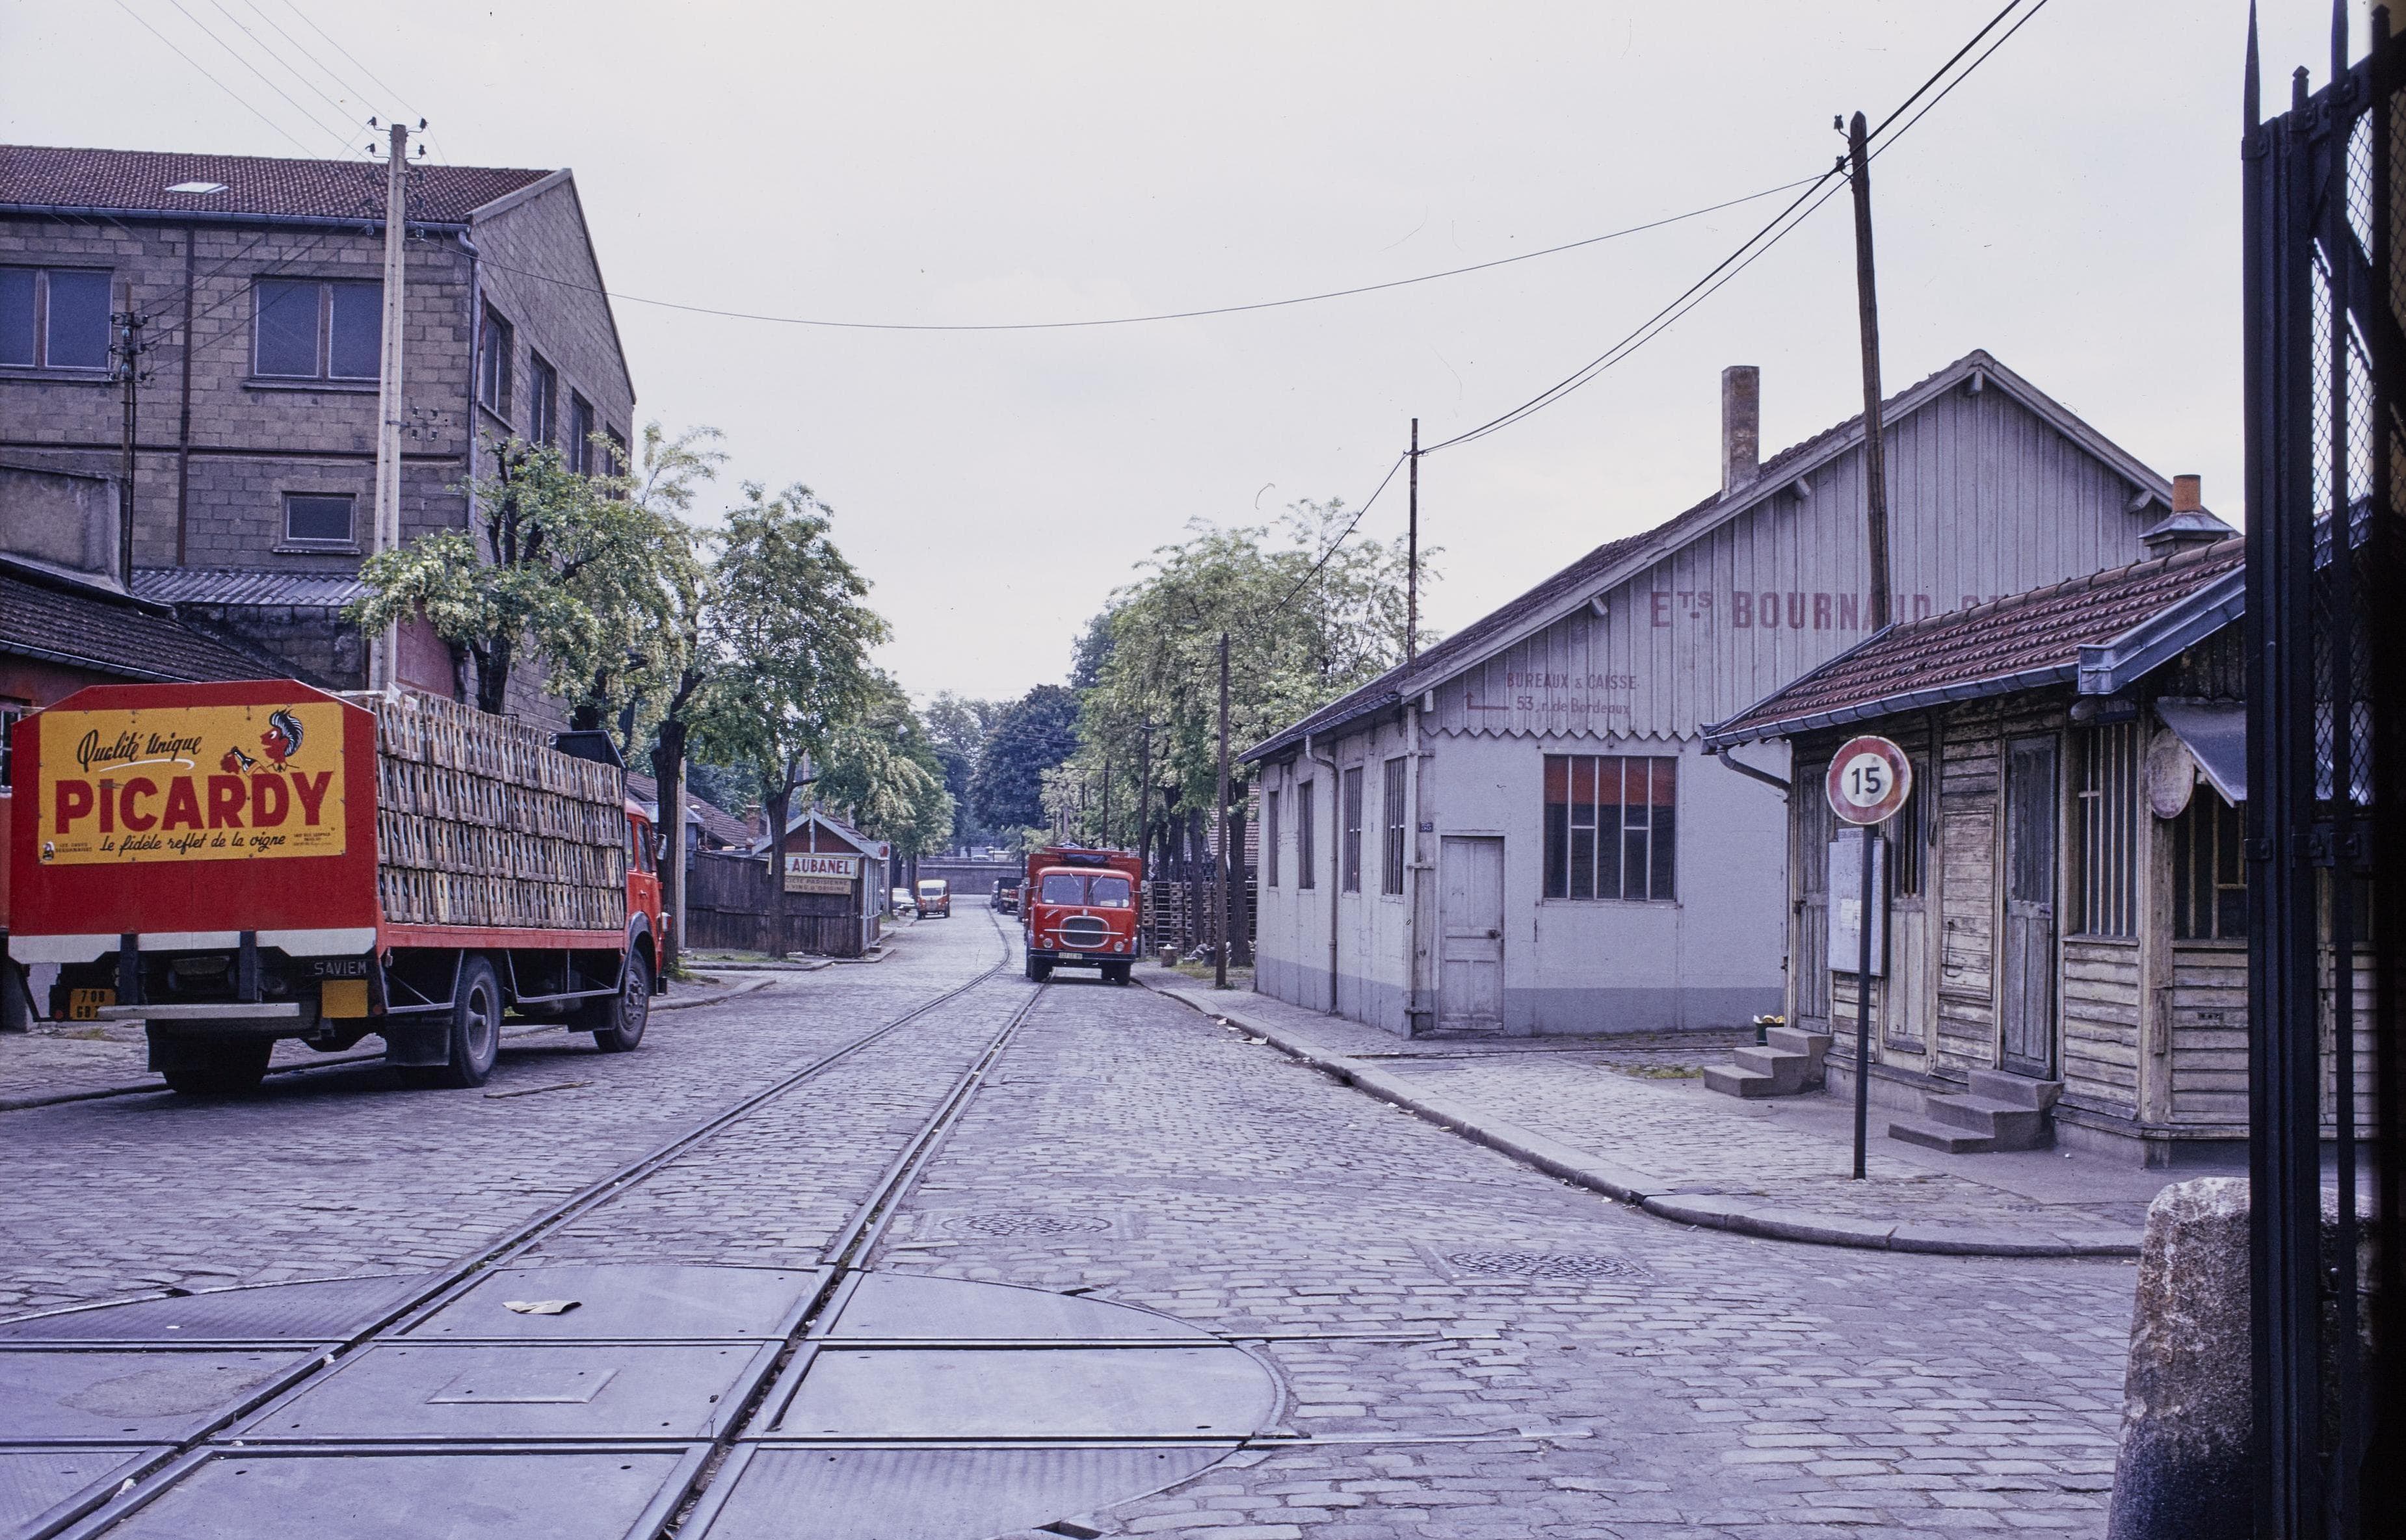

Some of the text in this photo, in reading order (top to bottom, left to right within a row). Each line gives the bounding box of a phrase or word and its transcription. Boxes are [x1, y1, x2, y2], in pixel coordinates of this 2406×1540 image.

[1507, 672, 1568, 689] BUREAUX
[1587, 674, 1637, 690] CAISSE
[1552, 697, 1568, 712] de
[1571, 698, 1631, 715] Bordeaux
[77, 729, 202, 773] Qualité Unique
[1852, 766, 1881, 794] 15
[56, 770, 334, 834] PICARDY
[99, 831, 285, 857] Le fidèle reflet de la vigne
[792, 858, 851, 874] AUBANEL
[314, 961, 366, 975] SAVIEM
